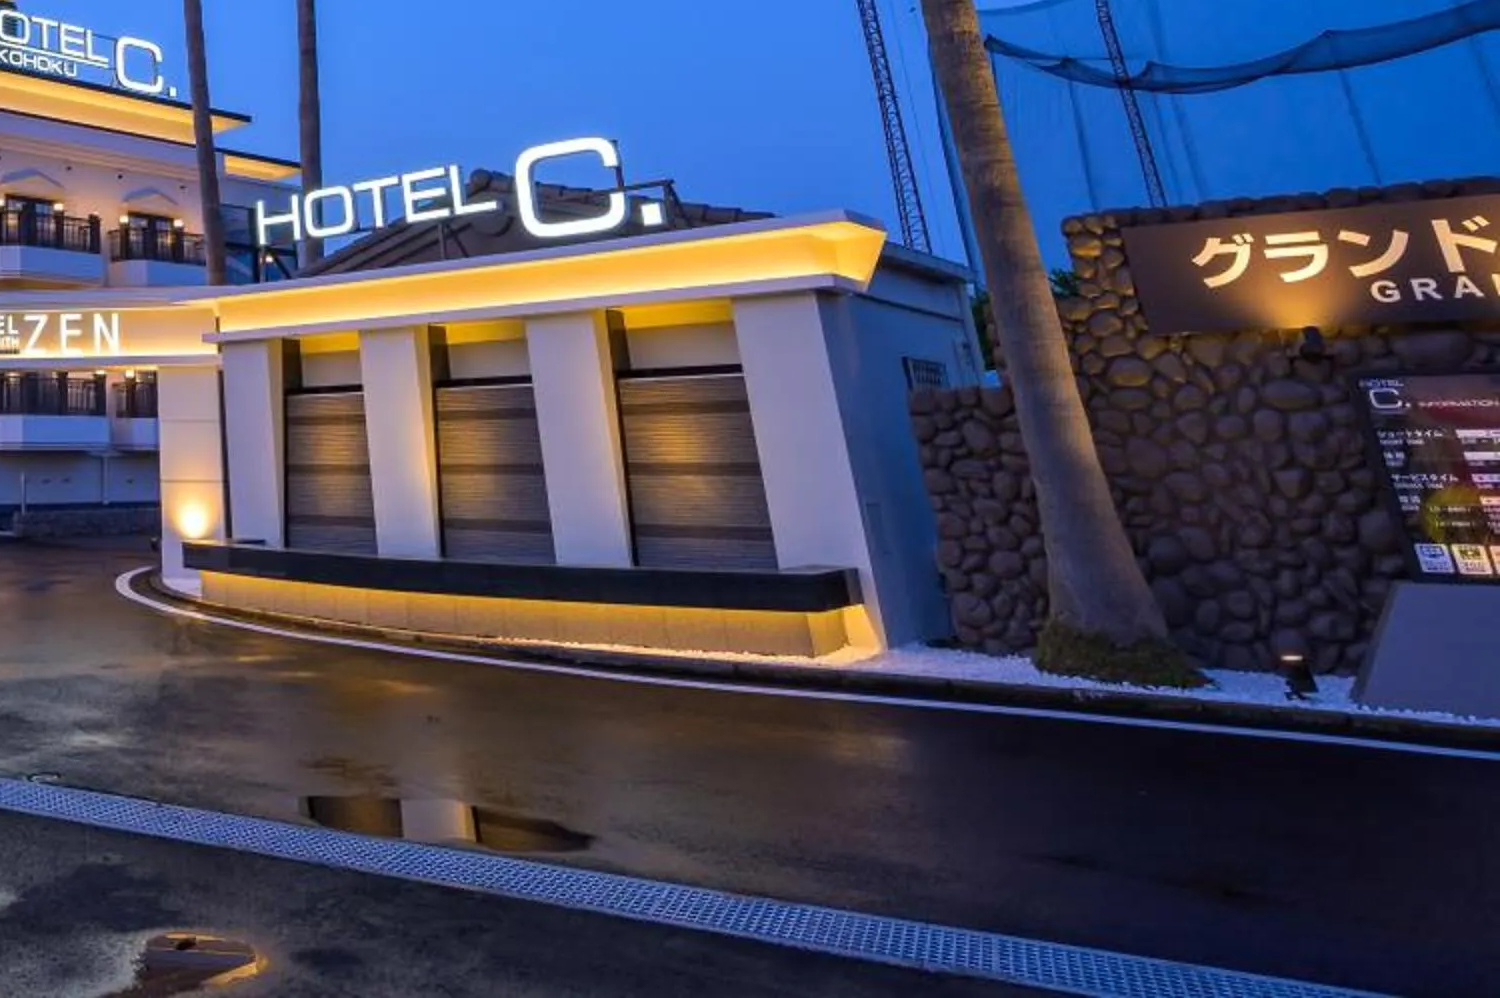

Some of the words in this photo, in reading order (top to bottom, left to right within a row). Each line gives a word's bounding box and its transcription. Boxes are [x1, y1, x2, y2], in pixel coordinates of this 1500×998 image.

[256, 164, 498, 246] HOTEL
[1191, 215, 1498, 289] グランド
[23, 313, 122, 358] ZEN
